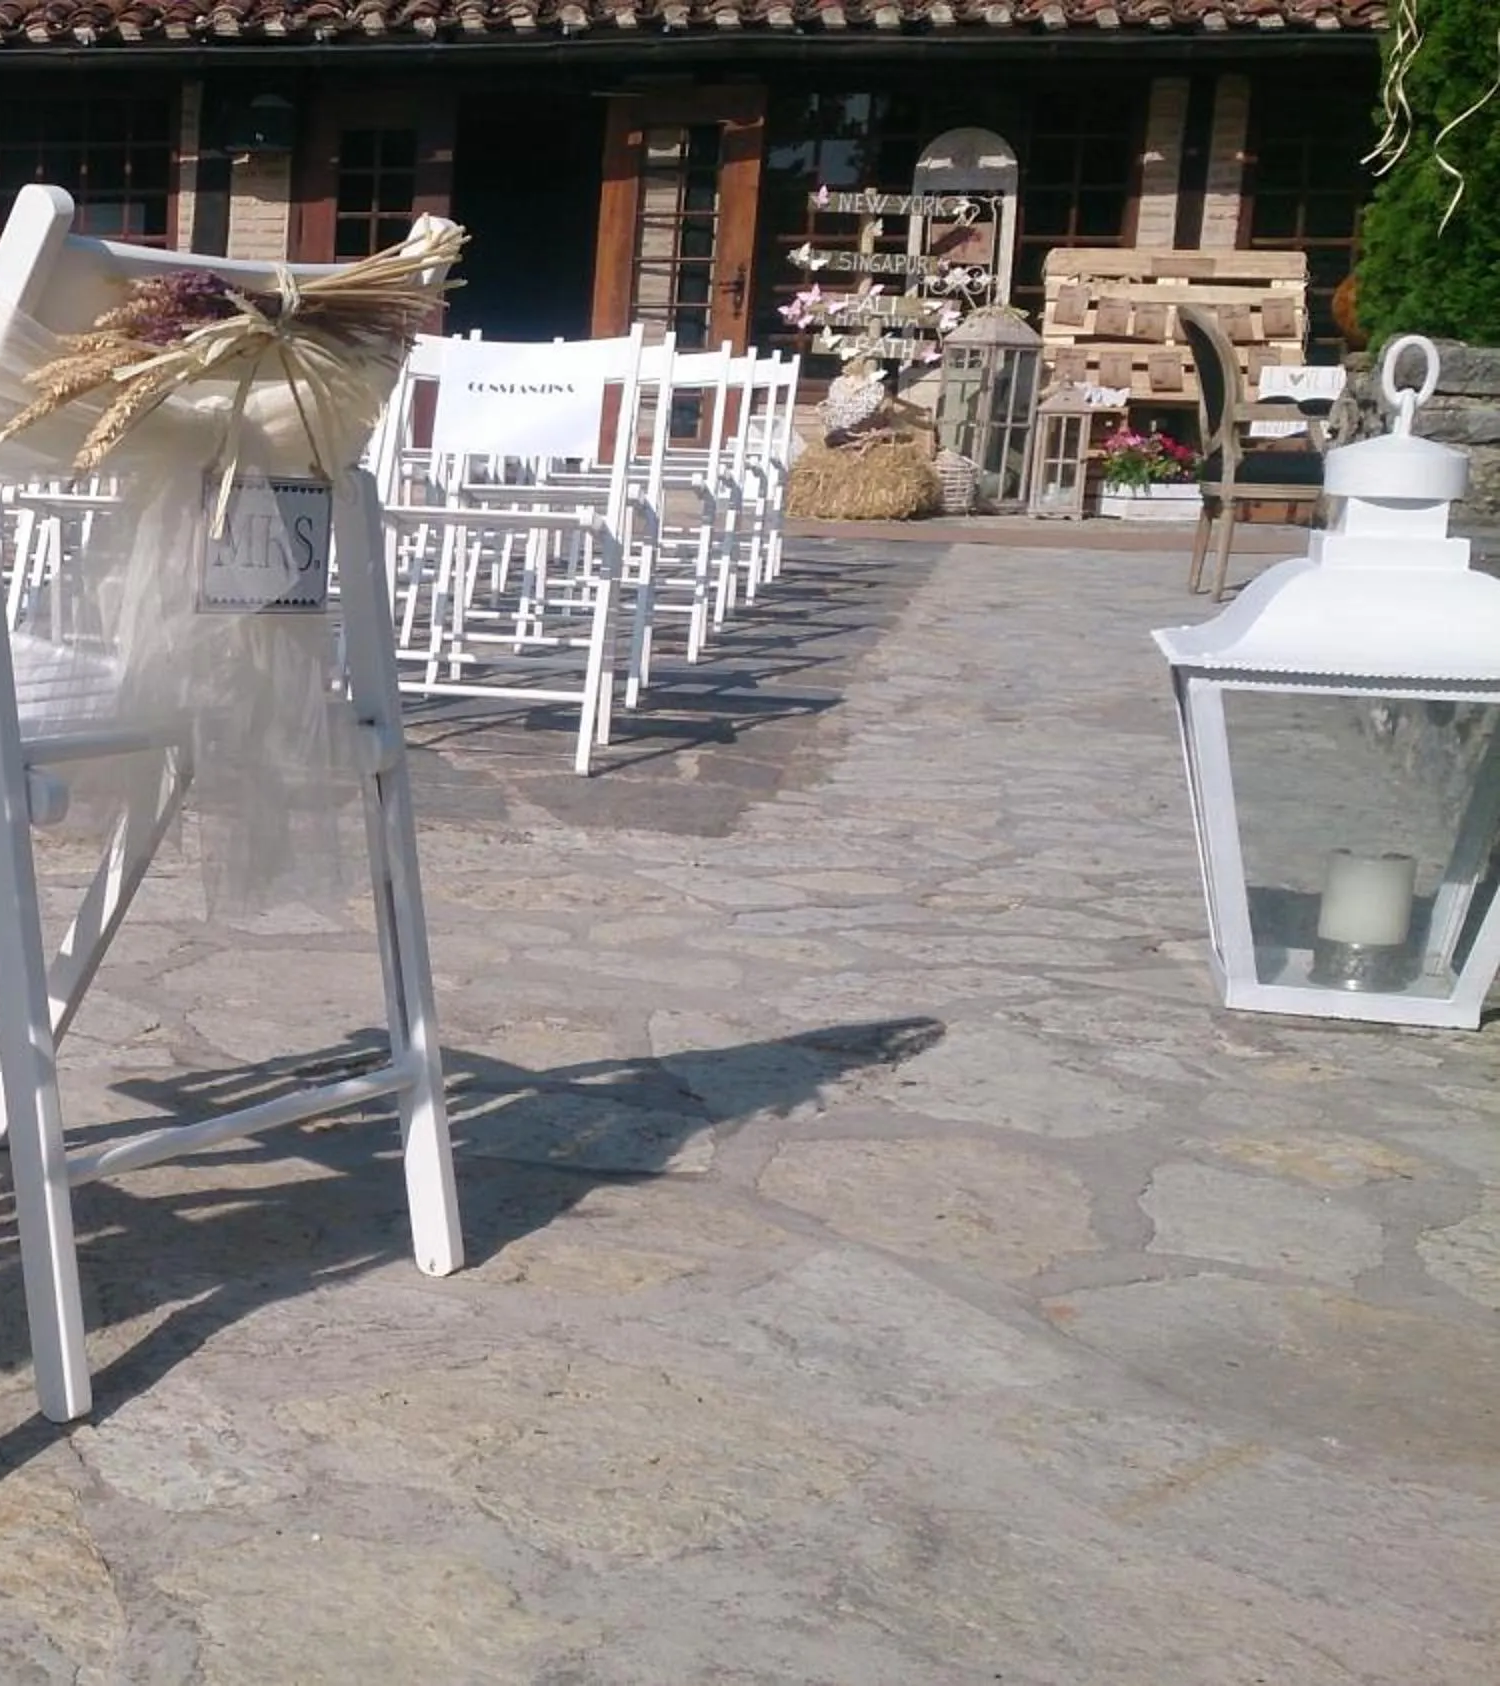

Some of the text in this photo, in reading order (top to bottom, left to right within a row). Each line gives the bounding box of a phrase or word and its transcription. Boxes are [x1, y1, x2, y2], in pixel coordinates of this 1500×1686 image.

[838, 193, 948, 217] NEW YORK
[837, 252, 932, 276] SINGAPUR
